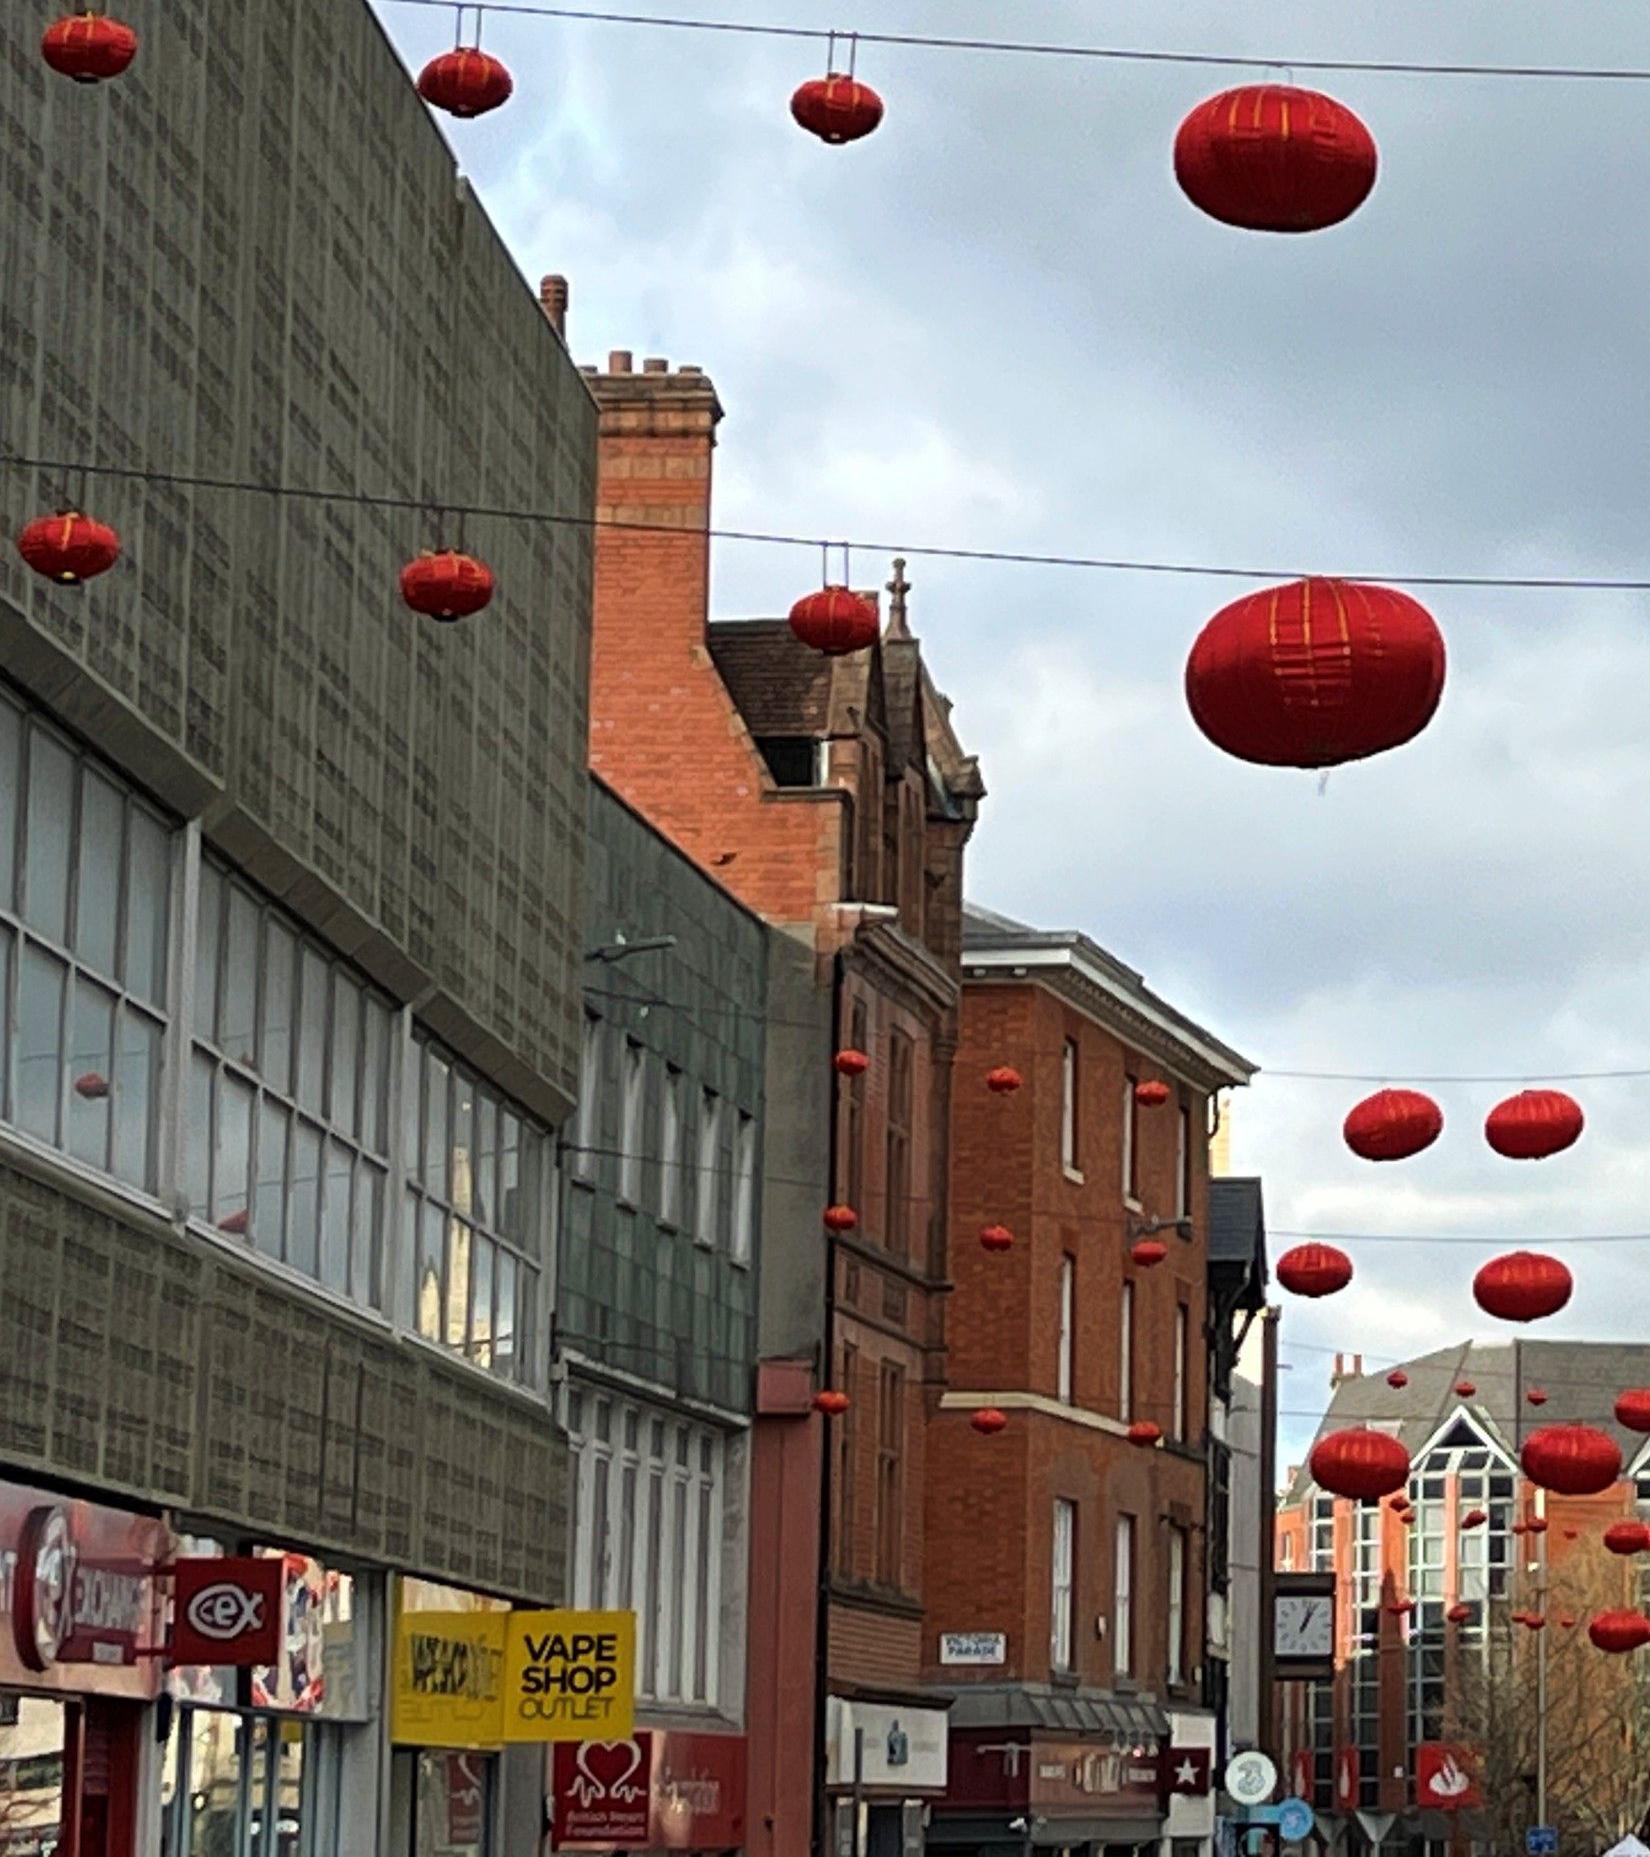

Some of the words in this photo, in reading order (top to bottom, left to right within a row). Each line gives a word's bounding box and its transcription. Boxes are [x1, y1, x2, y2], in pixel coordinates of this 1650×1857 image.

[523, 1634, 617, 1662] VAPE
[948, 1645, 996, 1656] PARADE
[521, 1666, 617, 1694] SHOP
[519, 1697, 615, 1720] OUTLET
